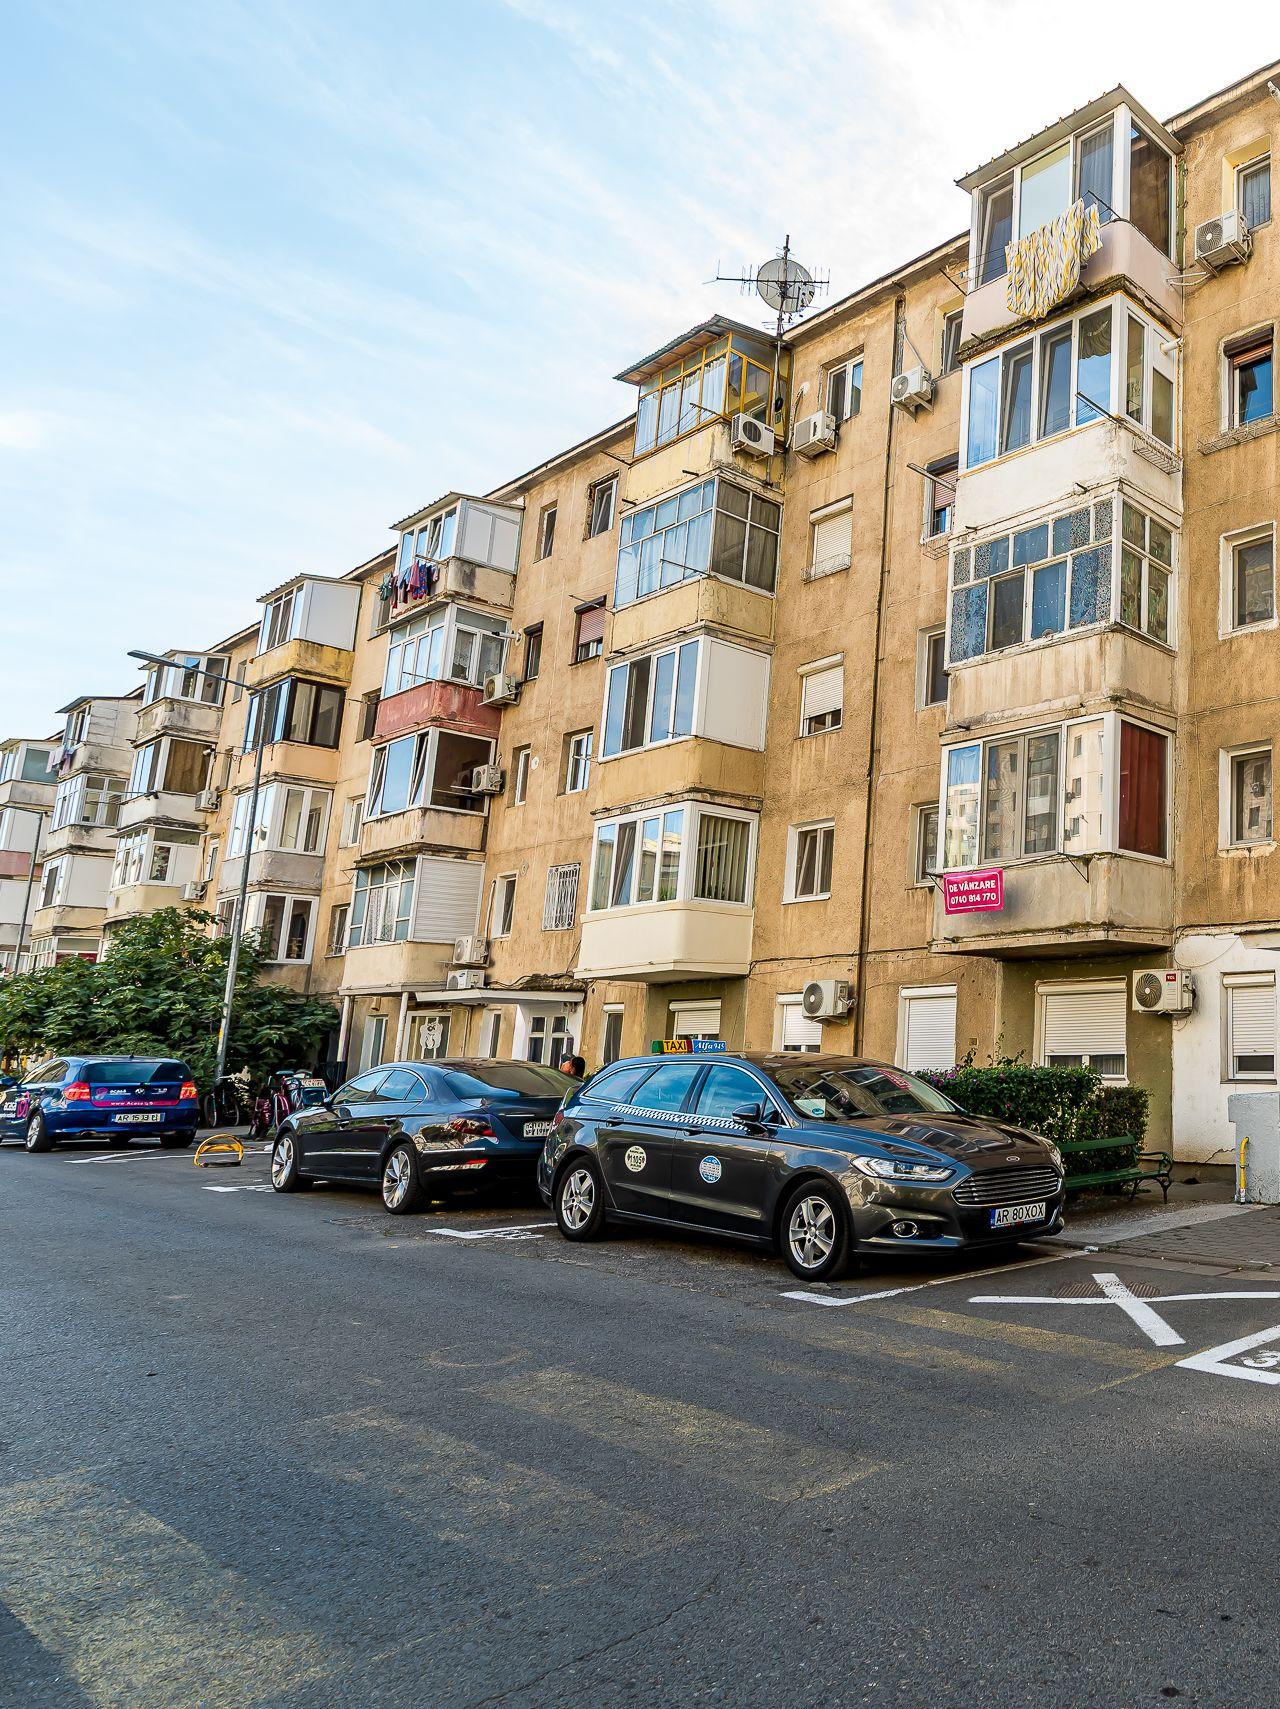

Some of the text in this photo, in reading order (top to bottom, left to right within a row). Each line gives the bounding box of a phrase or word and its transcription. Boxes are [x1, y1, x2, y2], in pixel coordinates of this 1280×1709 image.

[949, 879, 996, 893] DE VÂNZARE
[982, 891, 997, 902] 770
[664, 1041, 687, 1051] TAXI
[695, 1042, 713, 1051] Alfa
[996, 1209, 1010, 1224] AR
